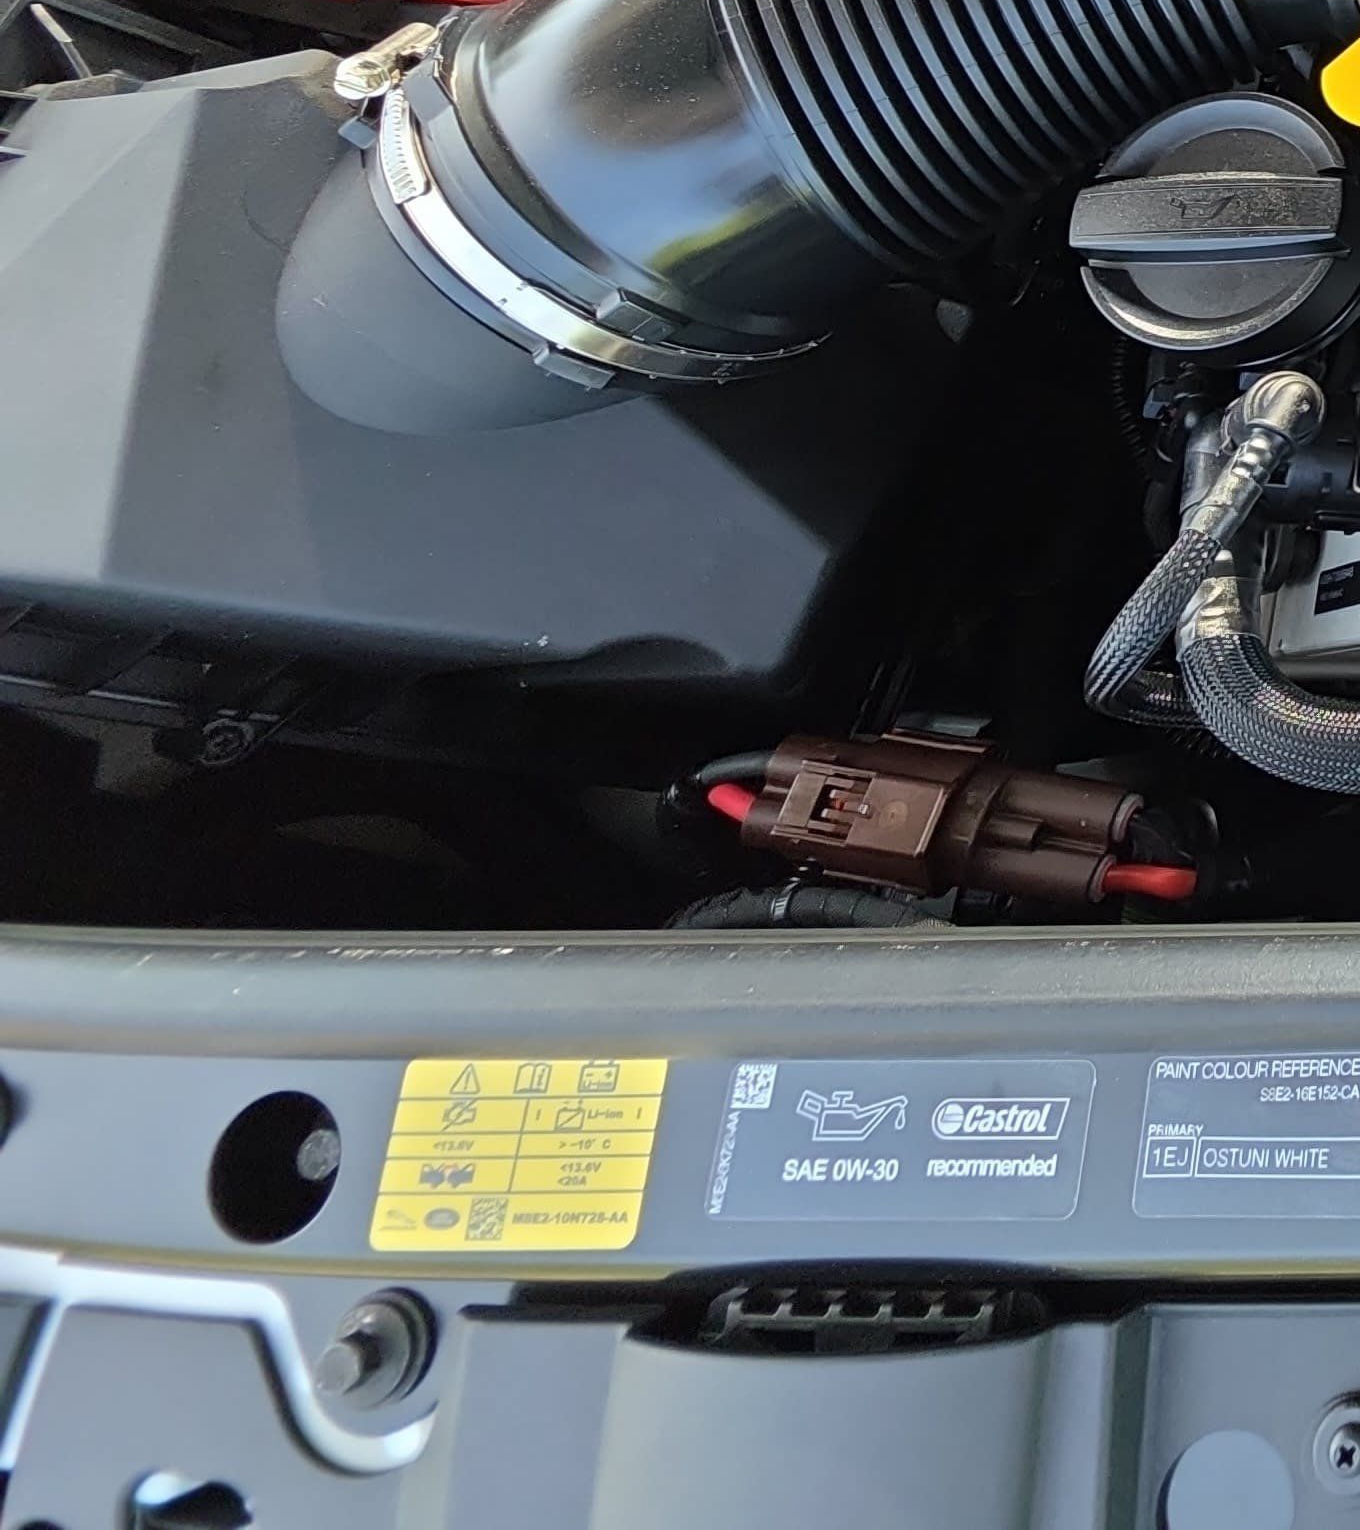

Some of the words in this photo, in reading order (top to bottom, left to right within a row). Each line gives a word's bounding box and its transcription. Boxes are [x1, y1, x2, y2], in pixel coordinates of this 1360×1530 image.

[1156, 1062, 1199, 1079] PAINT
[1202, 1061, 1269, 1079] COLOUR
[963, 1104, 1050, 1133] Castrol
[1148, 1124, 1204, 1136] PRIMARY
[926, 1154, 1057, 1177] recommended
[1153, 1147, 1189, 1167] 1EJ
[1203, 1148, 1269, 1169] OSTUNI
[1275, 1148, 1329, 1169] WHITE
[783, 1159, 829, 1181] SAE
[832, 1159, 899, 1181] 0W-30
